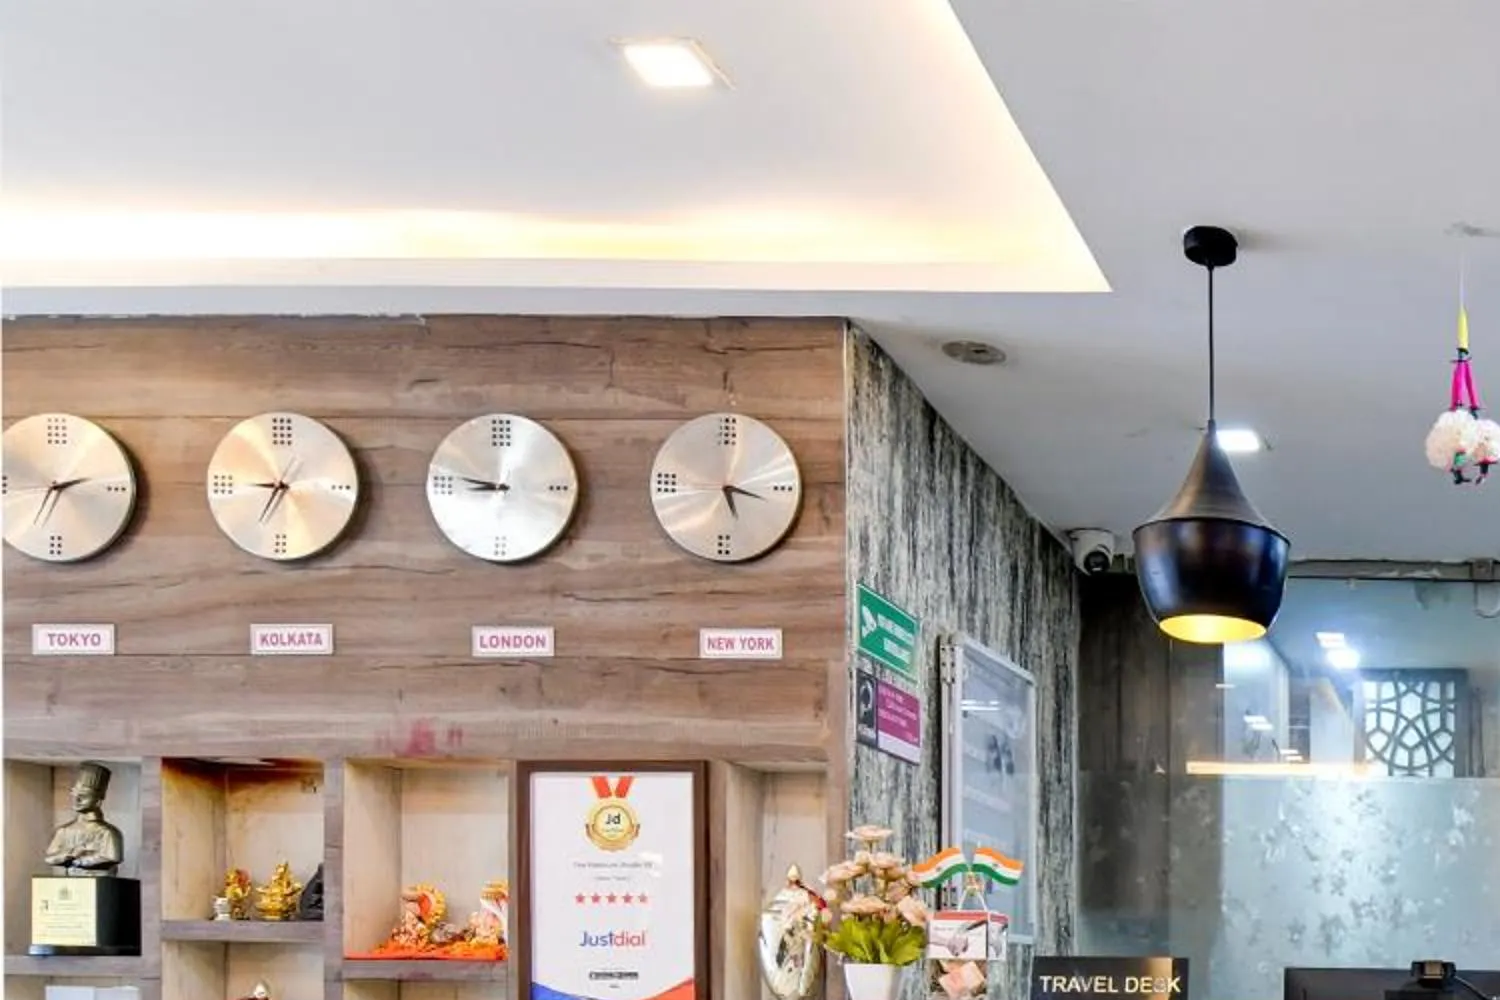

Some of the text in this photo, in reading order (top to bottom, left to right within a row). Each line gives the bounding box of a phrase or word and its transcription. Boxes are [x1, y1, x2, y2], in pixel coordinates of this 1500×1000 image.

[47, 632, 102, 648] TOKYO
[260, 632, 323, 647] KOLKATA
[479, 635, 546, 649] LONDON
[707, 636, 775, 651] NEW YORK
[579, 930, 645, 947] Justdial
[1039, 975, 1182, 993] TRAVEL DESK
